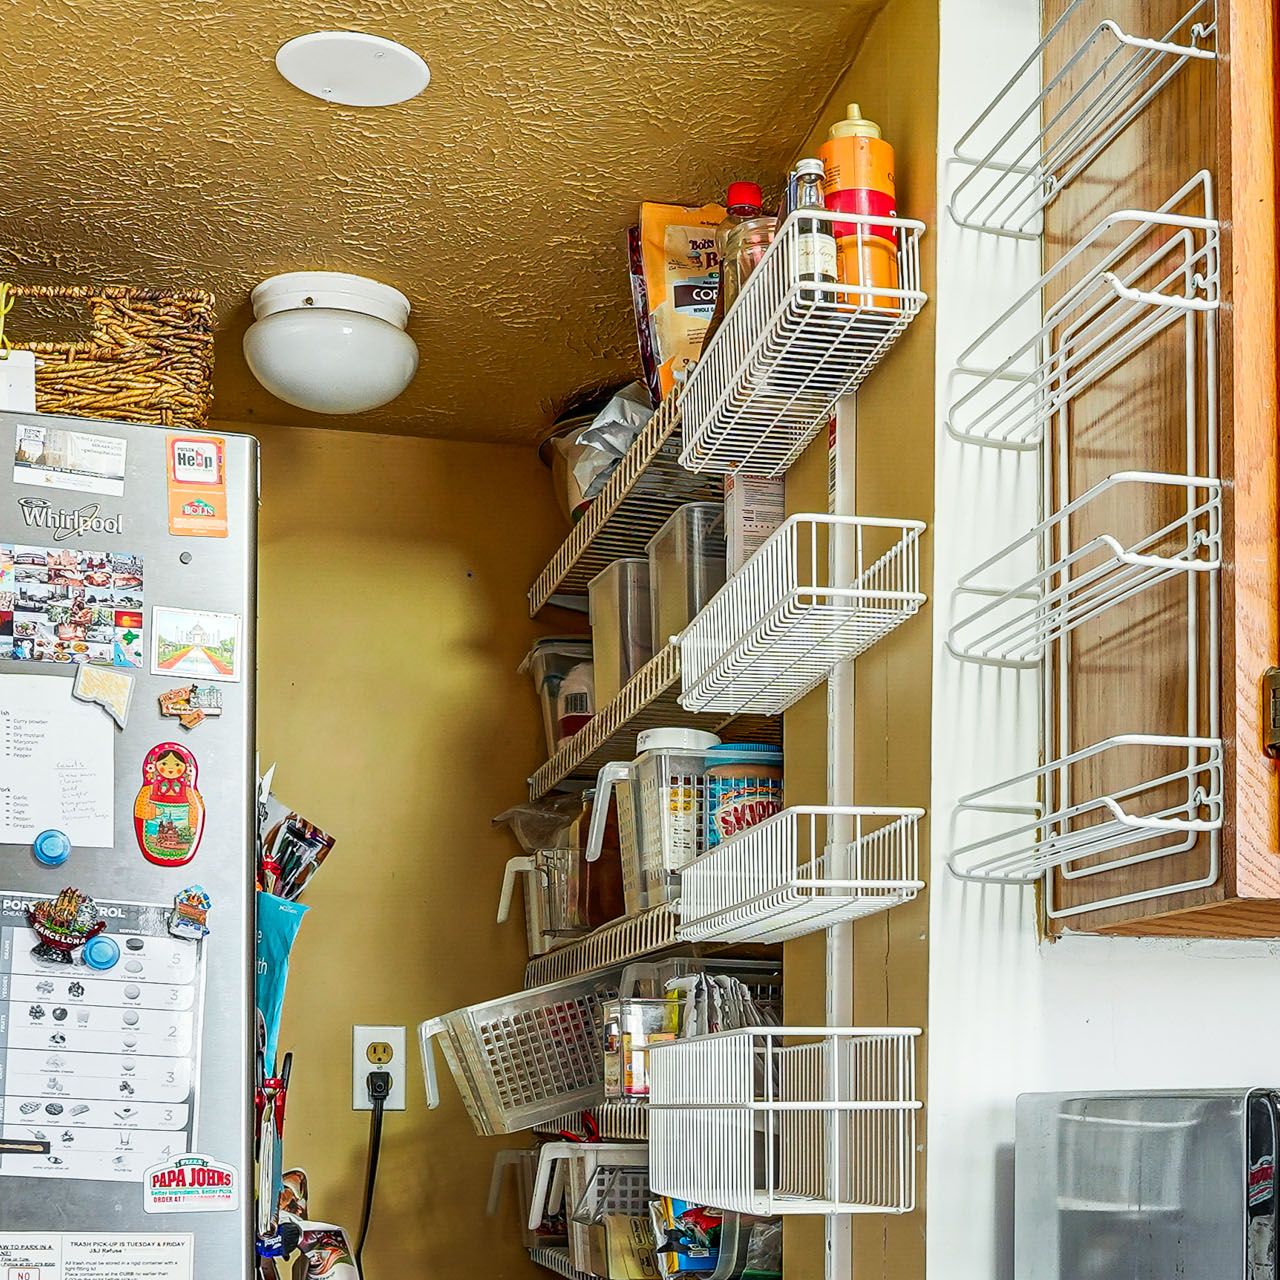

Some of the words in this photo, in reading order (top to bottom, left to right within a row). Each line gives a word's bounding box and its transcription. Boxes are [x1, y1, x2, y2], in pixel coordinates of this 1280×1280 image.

[22, 505, 123, 536] Whirlpool
[34, 923, 86, 945] BARCELONA
[172, 953, 181, 965] 5
[170, 989, 178, 1001] 3
[168, 1026, 177, 1038] 2
[166, 1071, 175, 1083] 3
[164, 1109, 173, 1121] 3
[152, 1170, 186, 1187] PAPA
[188, 1168, 231, 1187] JOHNS
[17, 1272, 30, 1280] NO
